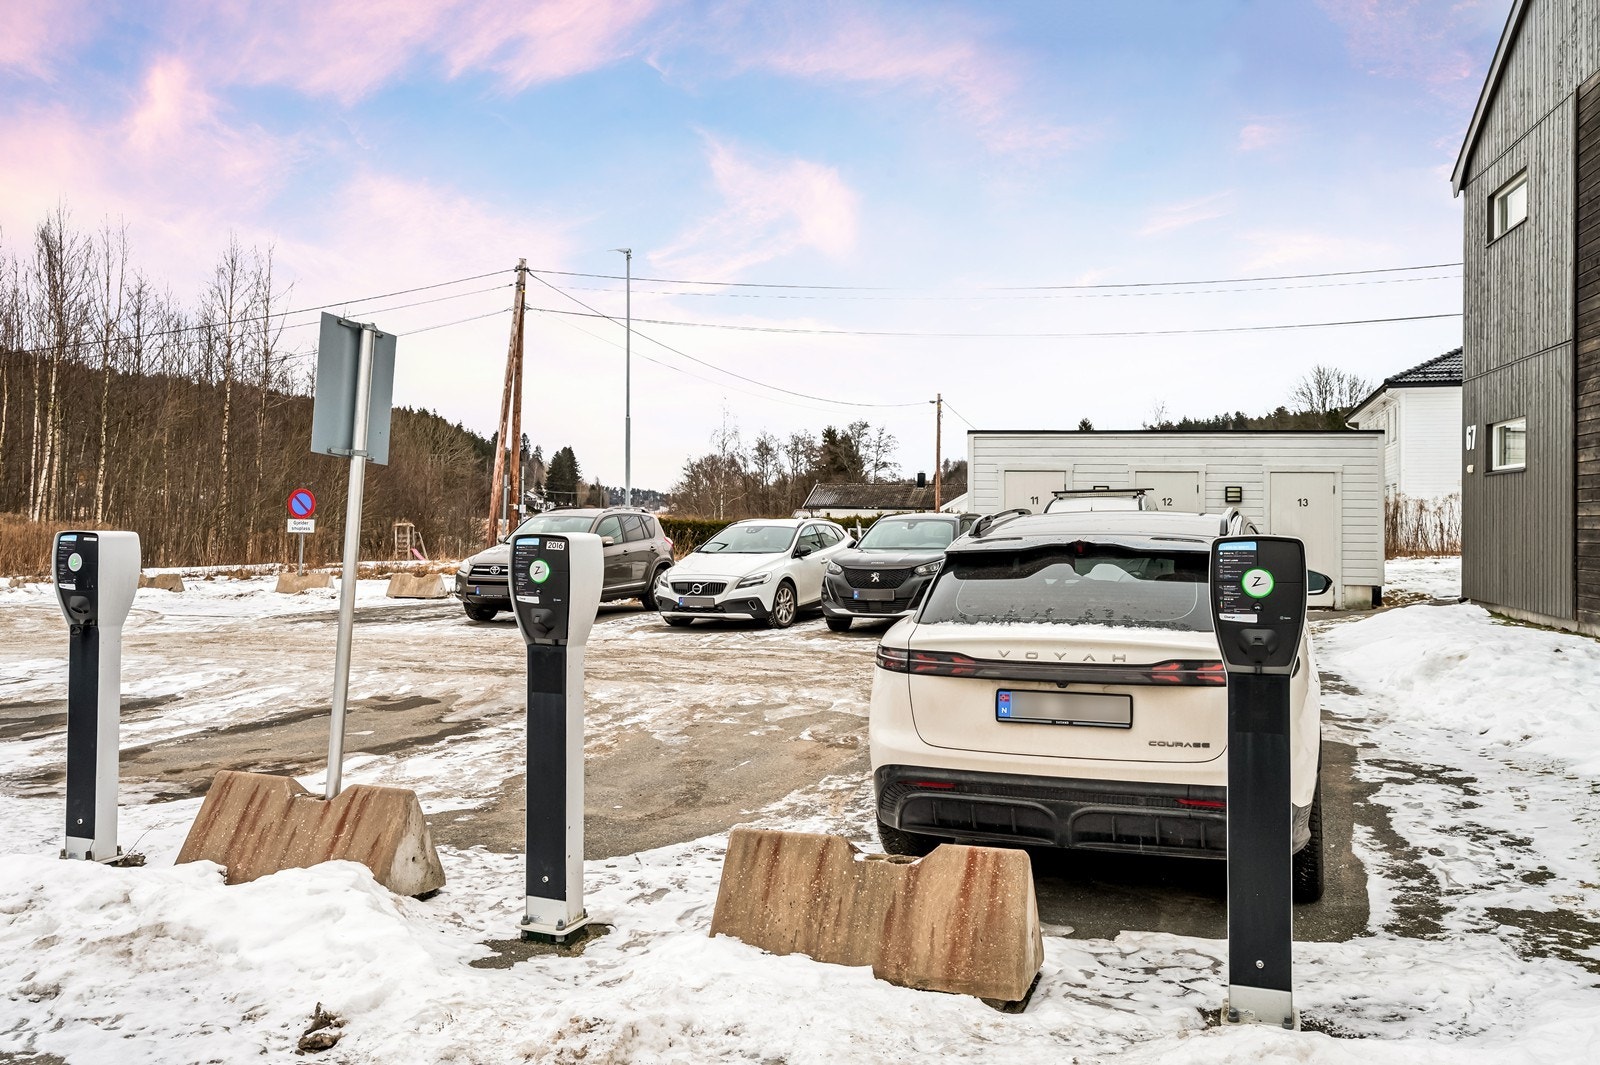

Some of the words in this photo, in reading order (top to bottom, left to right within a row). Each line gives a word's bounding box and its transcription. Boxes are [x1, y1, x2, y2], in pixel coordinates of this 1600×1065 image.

[1466, 425, 1476, 450] 67
[1030, 496, 1039, 505] 11
[1162, 497, 1173, 506] 12
[1297, 498, 1309, 507] 13
[1251, 576, 1267, 588] Z
[998, 650, 1126, 662] VOYAH
